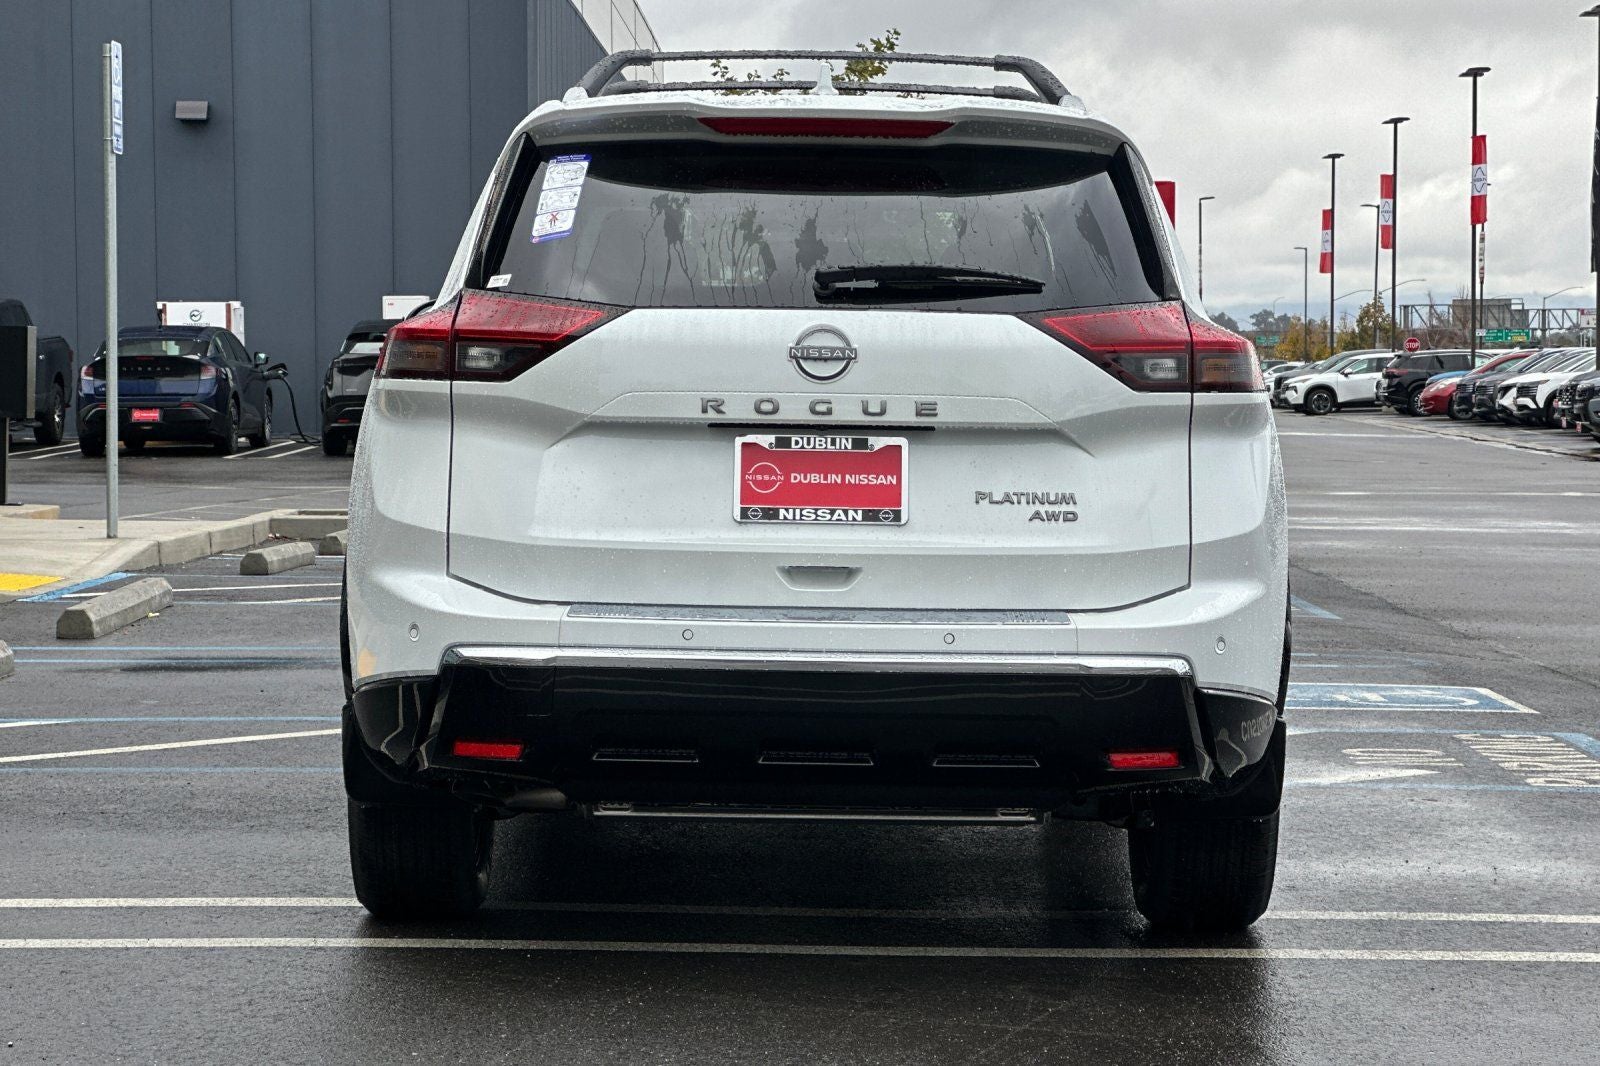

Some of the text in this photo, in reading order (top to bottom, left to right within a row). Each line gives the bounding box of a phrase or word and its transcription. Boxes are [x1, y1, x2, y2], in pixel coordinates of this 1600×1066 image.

[791, 348, 856, 358] NISSAN
[701, 397, 938, 417] ROGUE
[791, 436, 852, 450] DUBLIN
[790, 473, 897, 485] DUBLIN NISSAN
[975, 491, 1077, 505] PLATINUM
[779, 508, 862, 521] NISSAN
[1028, 509, 1079, 522] AWD
